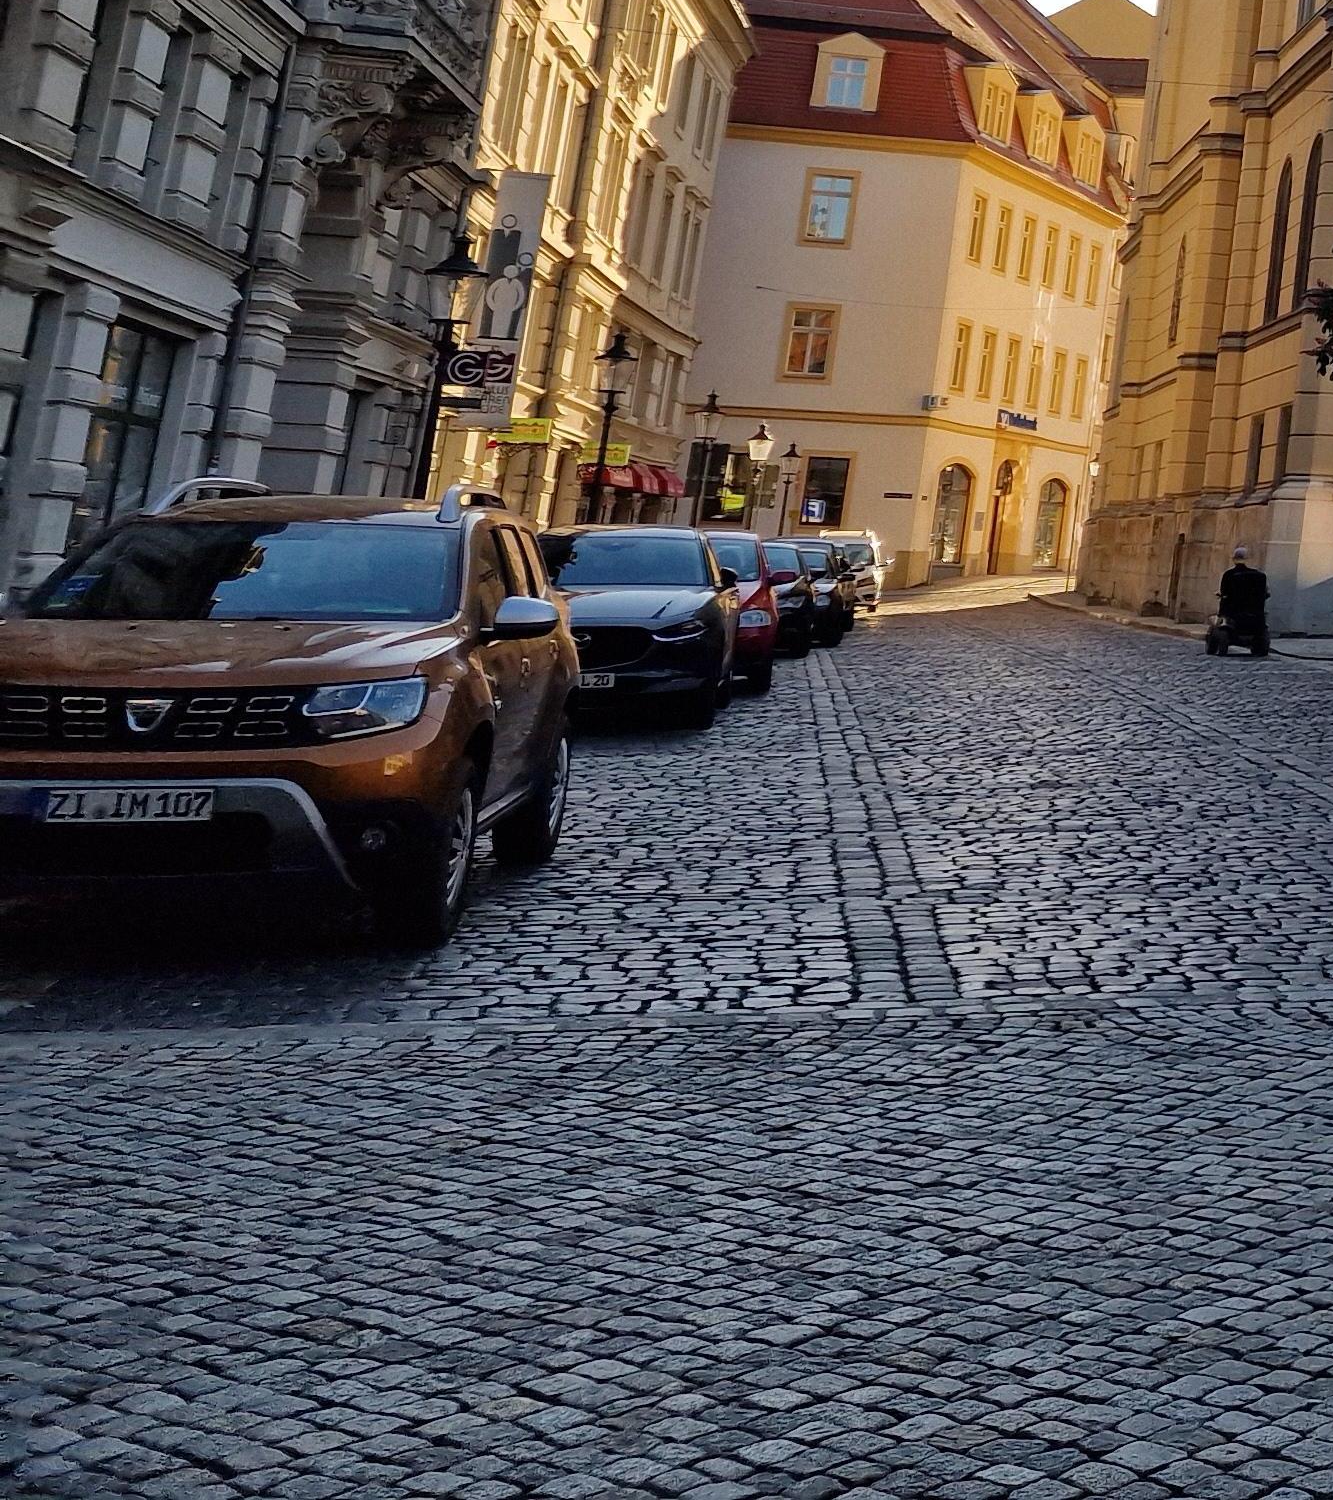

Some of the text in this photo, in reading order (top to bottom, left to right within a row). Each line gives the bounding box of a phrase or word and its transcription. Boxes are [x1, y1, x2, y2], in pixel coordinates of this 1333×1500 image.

[593, 675, 610, 687] 20
[47, 791, 213, 819] ZI IM 107
